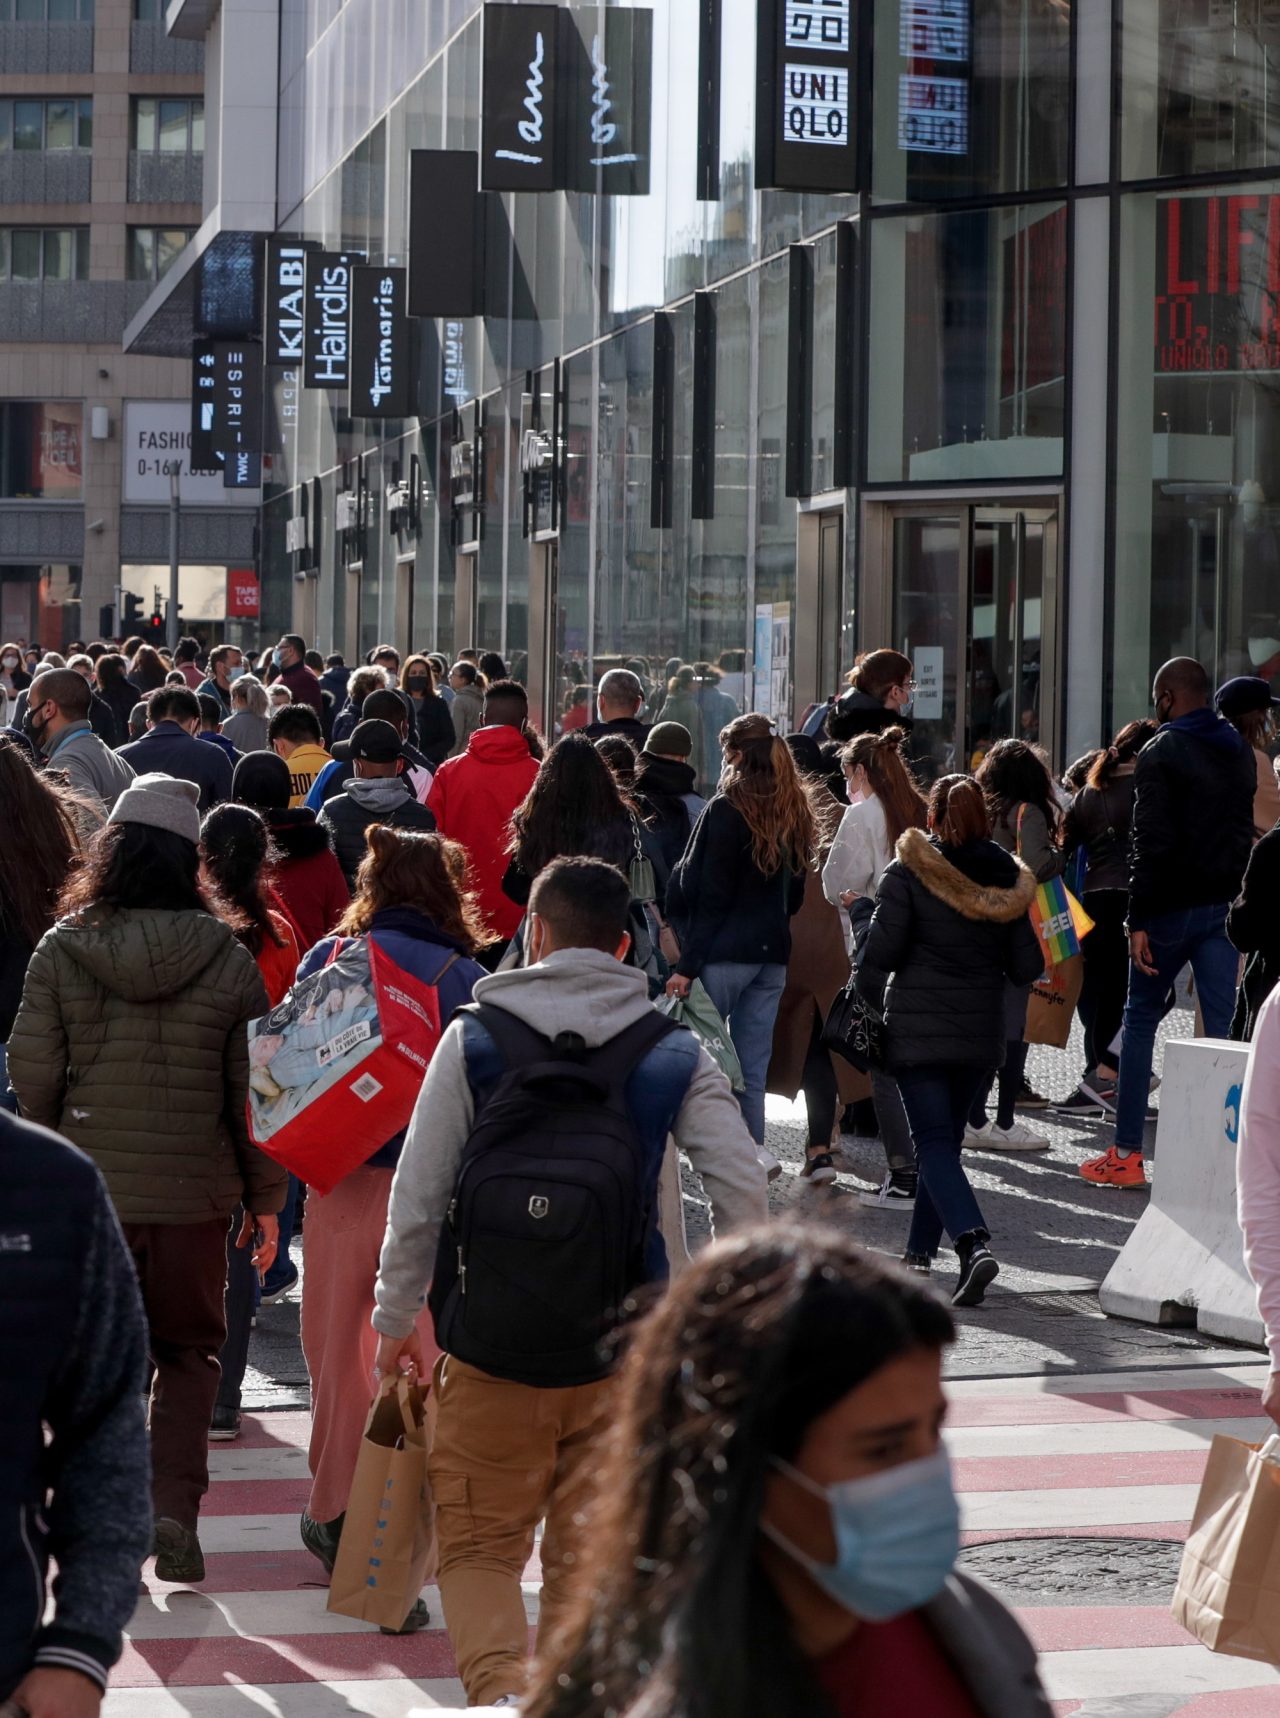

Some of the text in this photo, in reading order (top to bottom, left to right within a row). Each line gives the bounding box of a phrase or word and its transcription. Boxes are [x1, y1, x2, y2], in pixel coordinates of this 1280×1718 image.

[789, 71, 839, 102] UNI
[789, 106, 843, 139] QLO
[278, 248, 304, 357] KIABI
